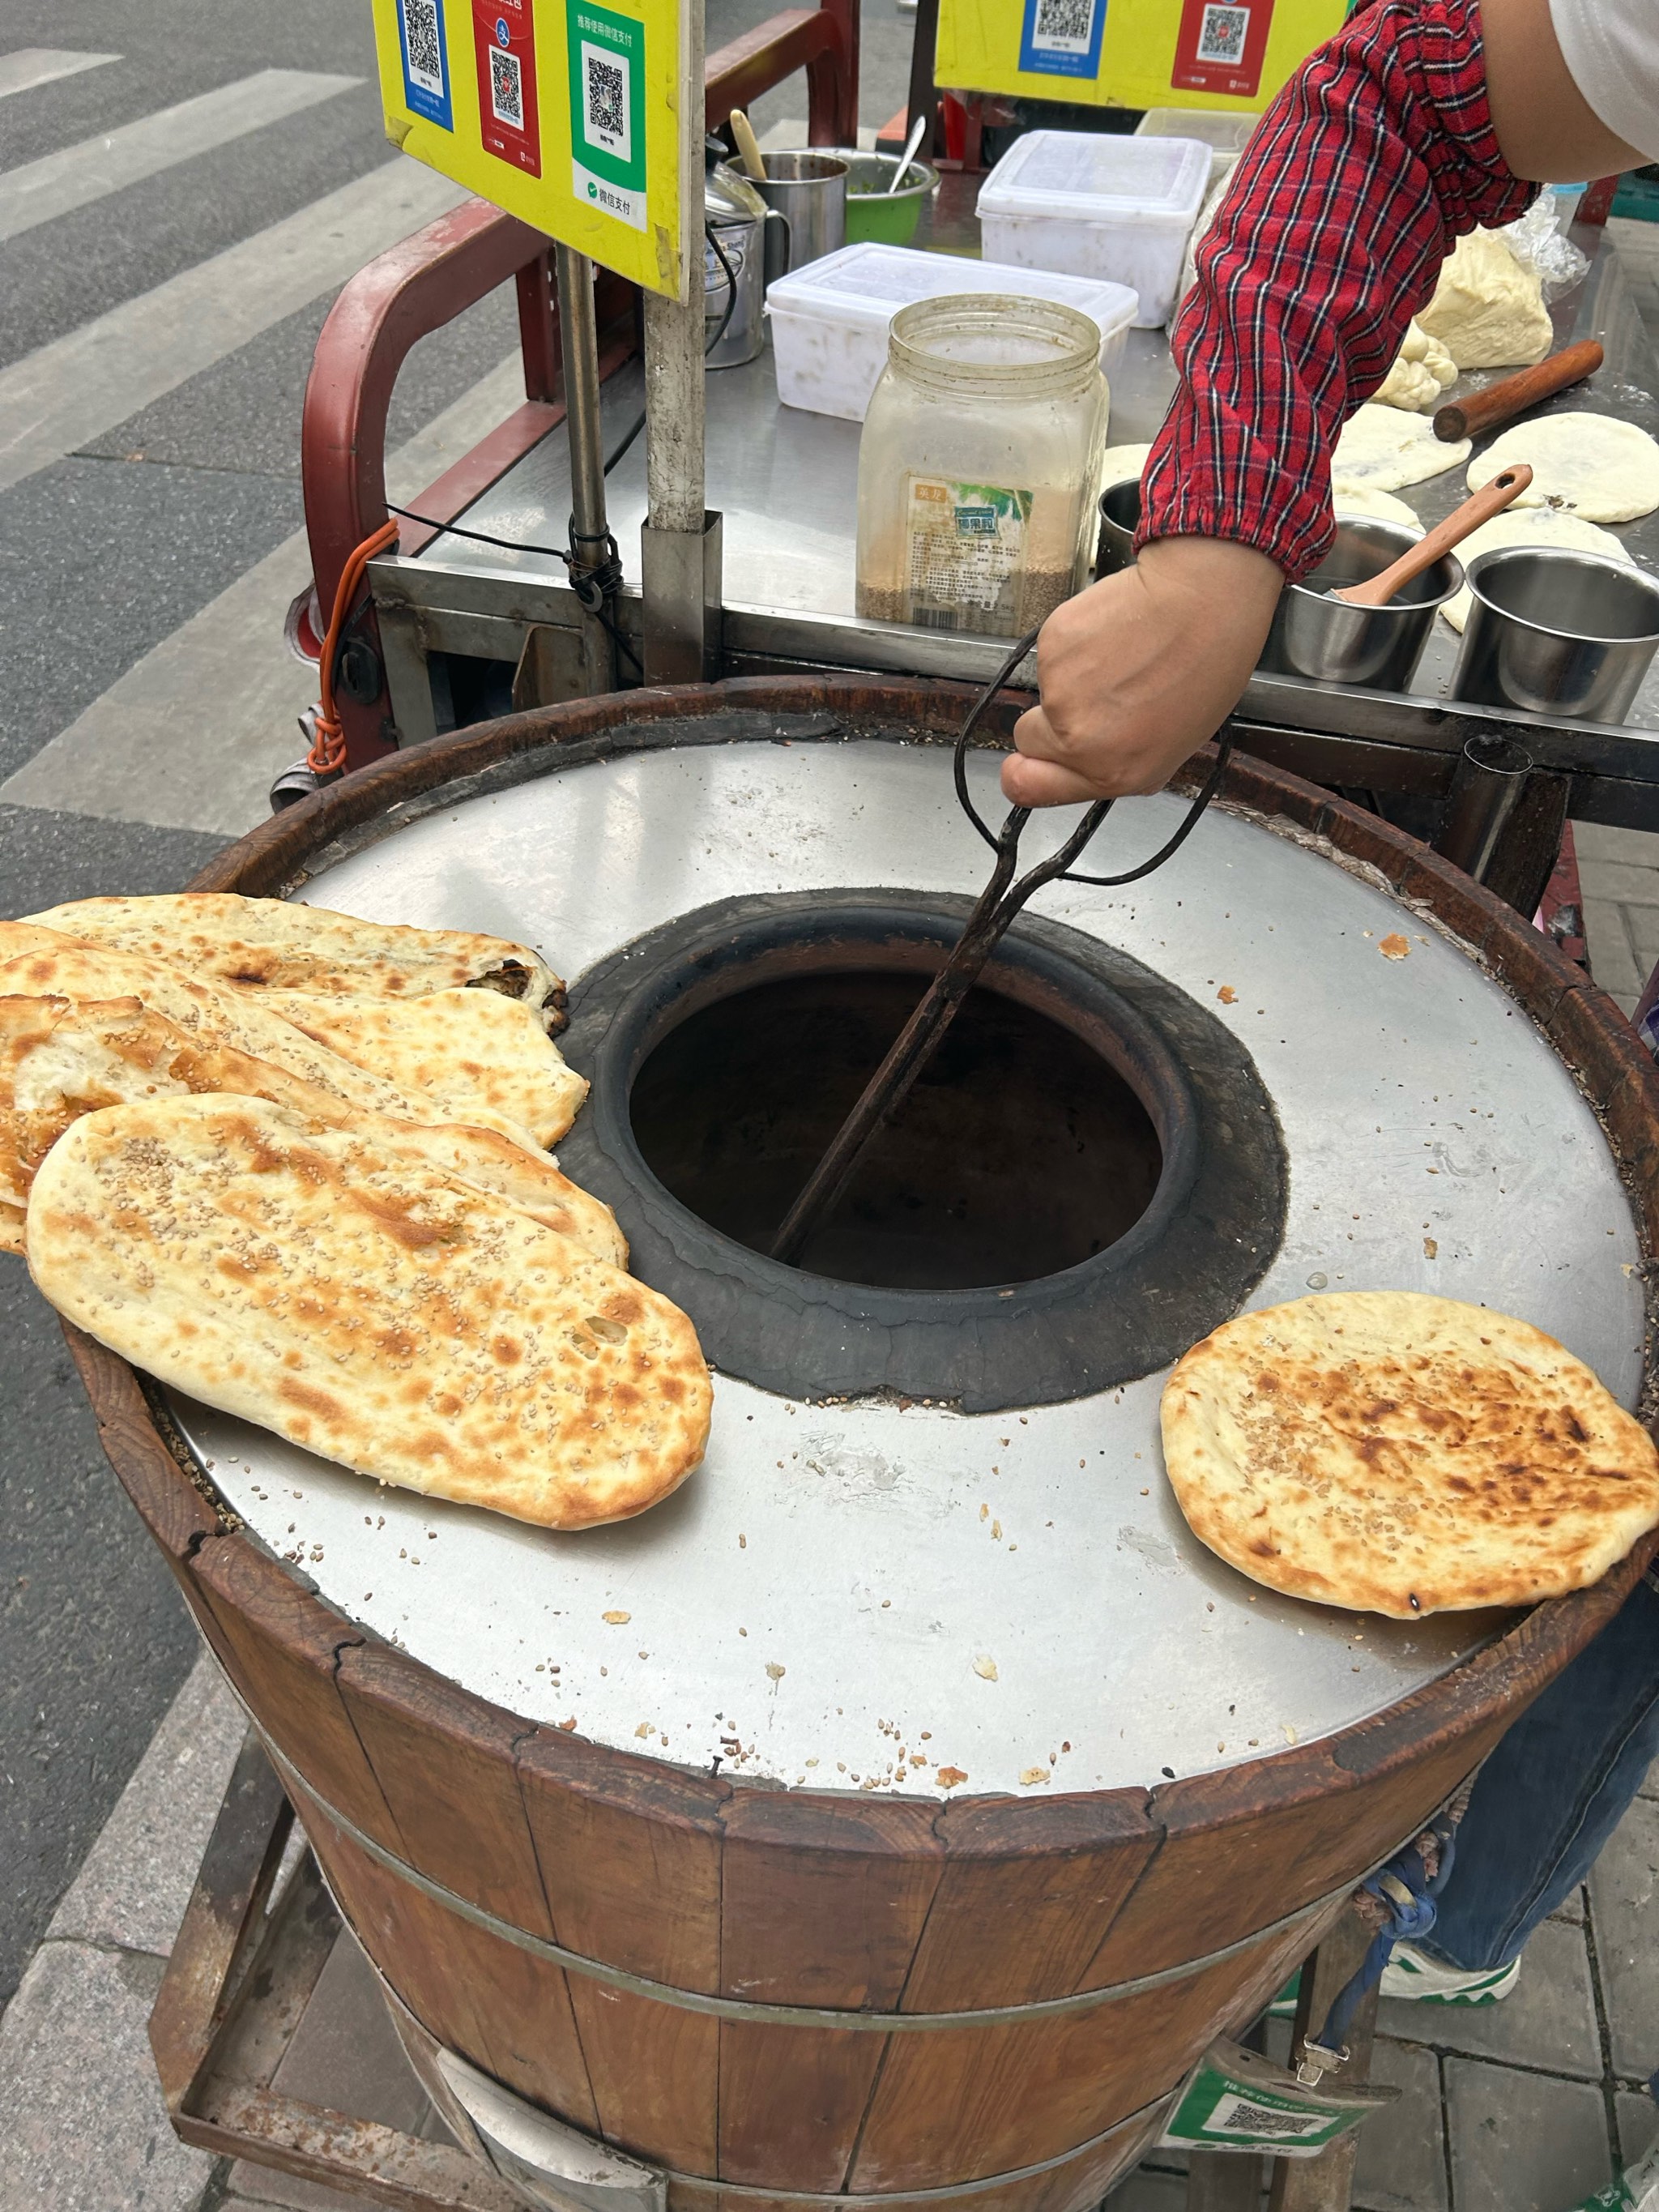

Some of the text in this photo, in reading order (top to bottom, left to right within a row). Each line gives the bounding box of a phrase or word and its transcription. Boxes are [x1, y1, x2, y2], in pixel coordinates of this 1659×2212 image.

[577, 13, 632, 47] 推荐使用微信支付
[599, 188, 630, 216] 微信支付
